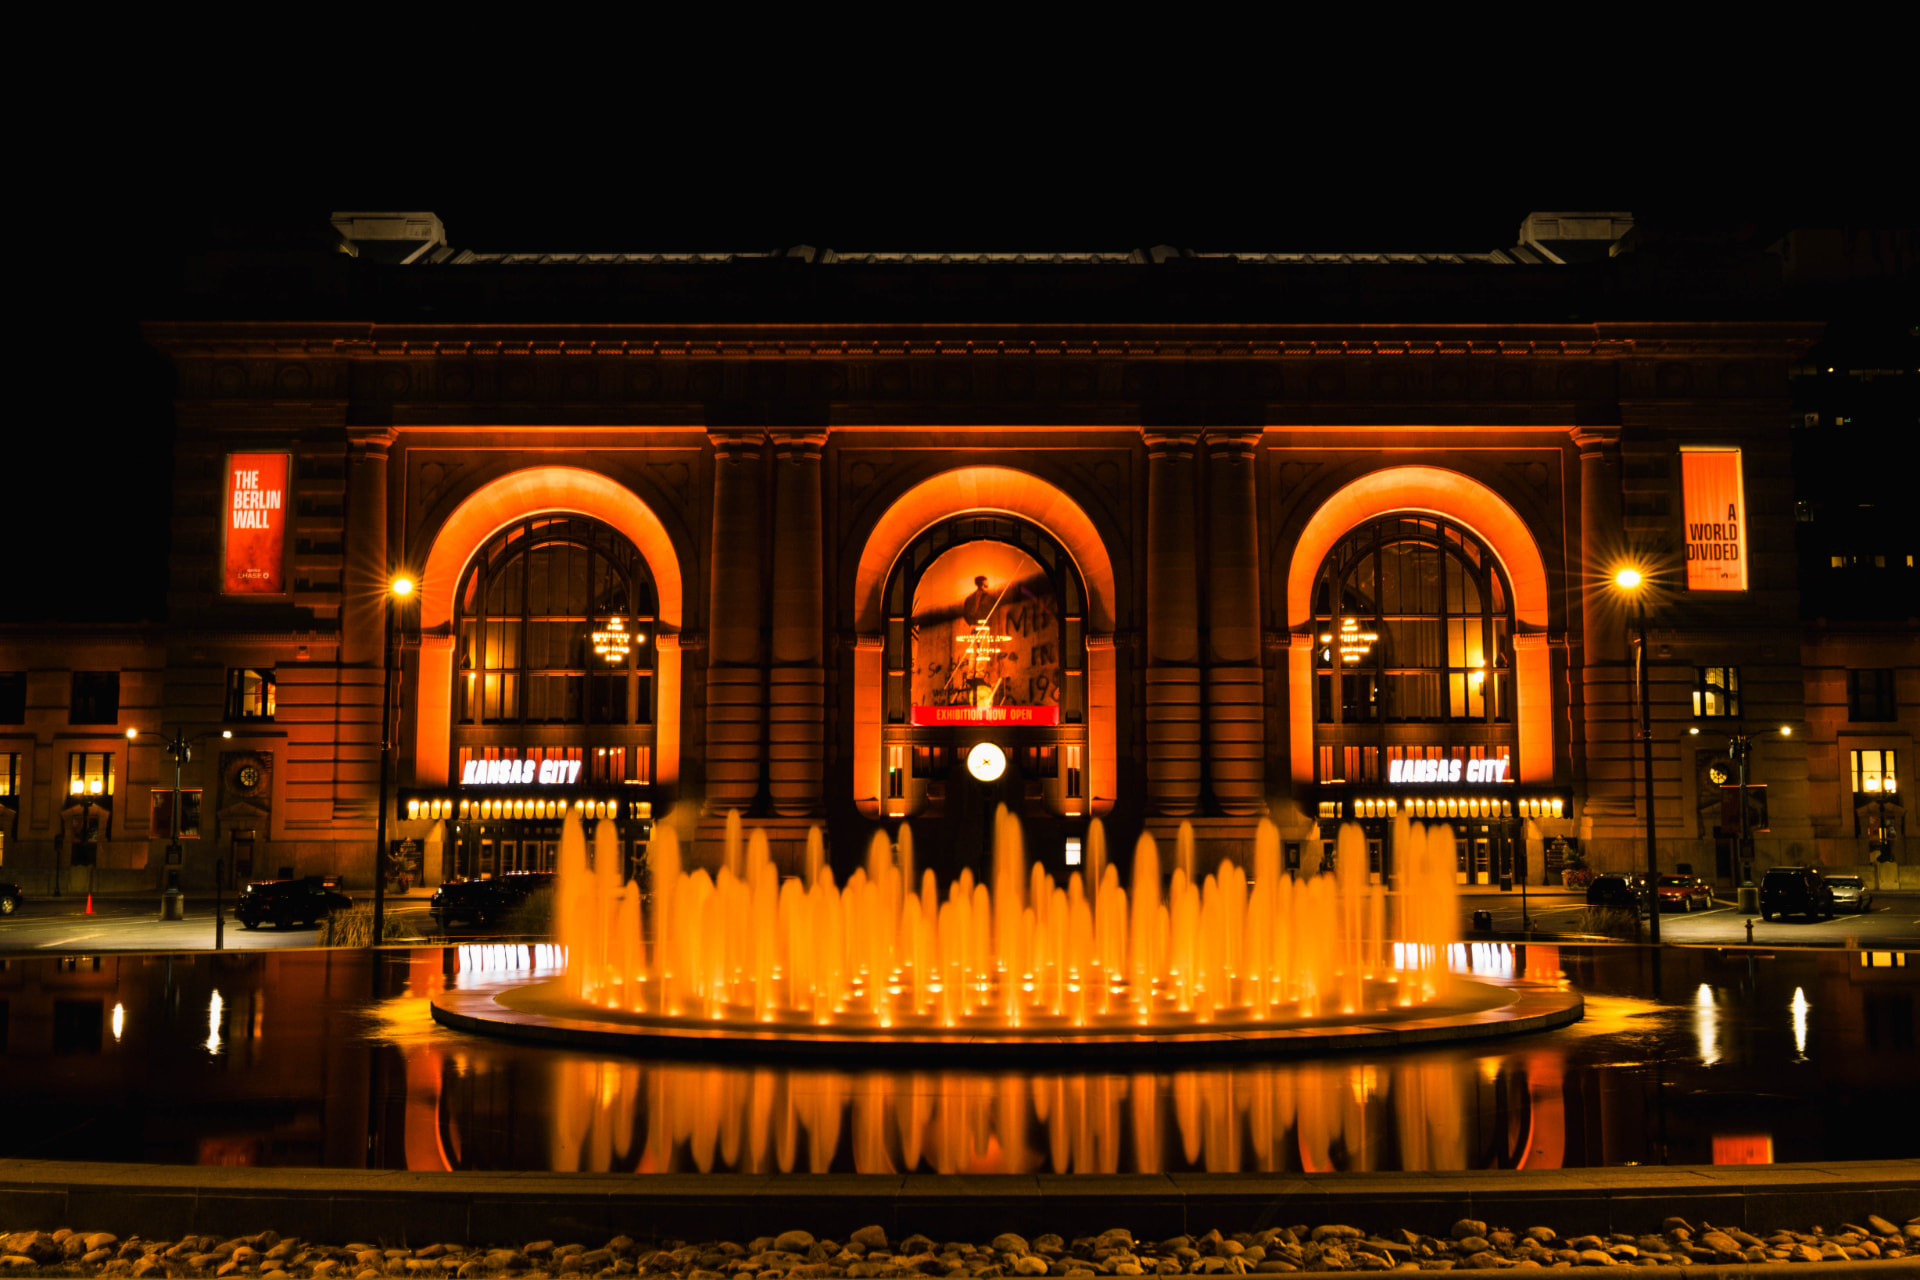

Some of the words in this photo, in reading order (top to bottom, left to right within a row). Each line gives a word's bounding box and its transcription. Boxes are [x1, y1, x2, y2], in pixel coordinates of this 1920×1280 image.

[234, 470, 259, 489] THE
[233, 490, 280, 509] BERLIN
[233, 510, 269, 528] WALL
[1728, 504, 1736, 520] A
[1689, 523, 1737, 540] WORLD
[1686, 543, 1738, 560] DIVIDED
[936, 709, 983, 721] EXHIBITION
[985, 708, 1006, 721] NOW
[1010, 708, 1032, 721] OPEN
[463, 759, 536, 784] KANSAS
[539, 759, 582, 784] CITY
[1389, 759, 1462, 783] KANSAS
[1466, 759, 1507, 783] CITY
